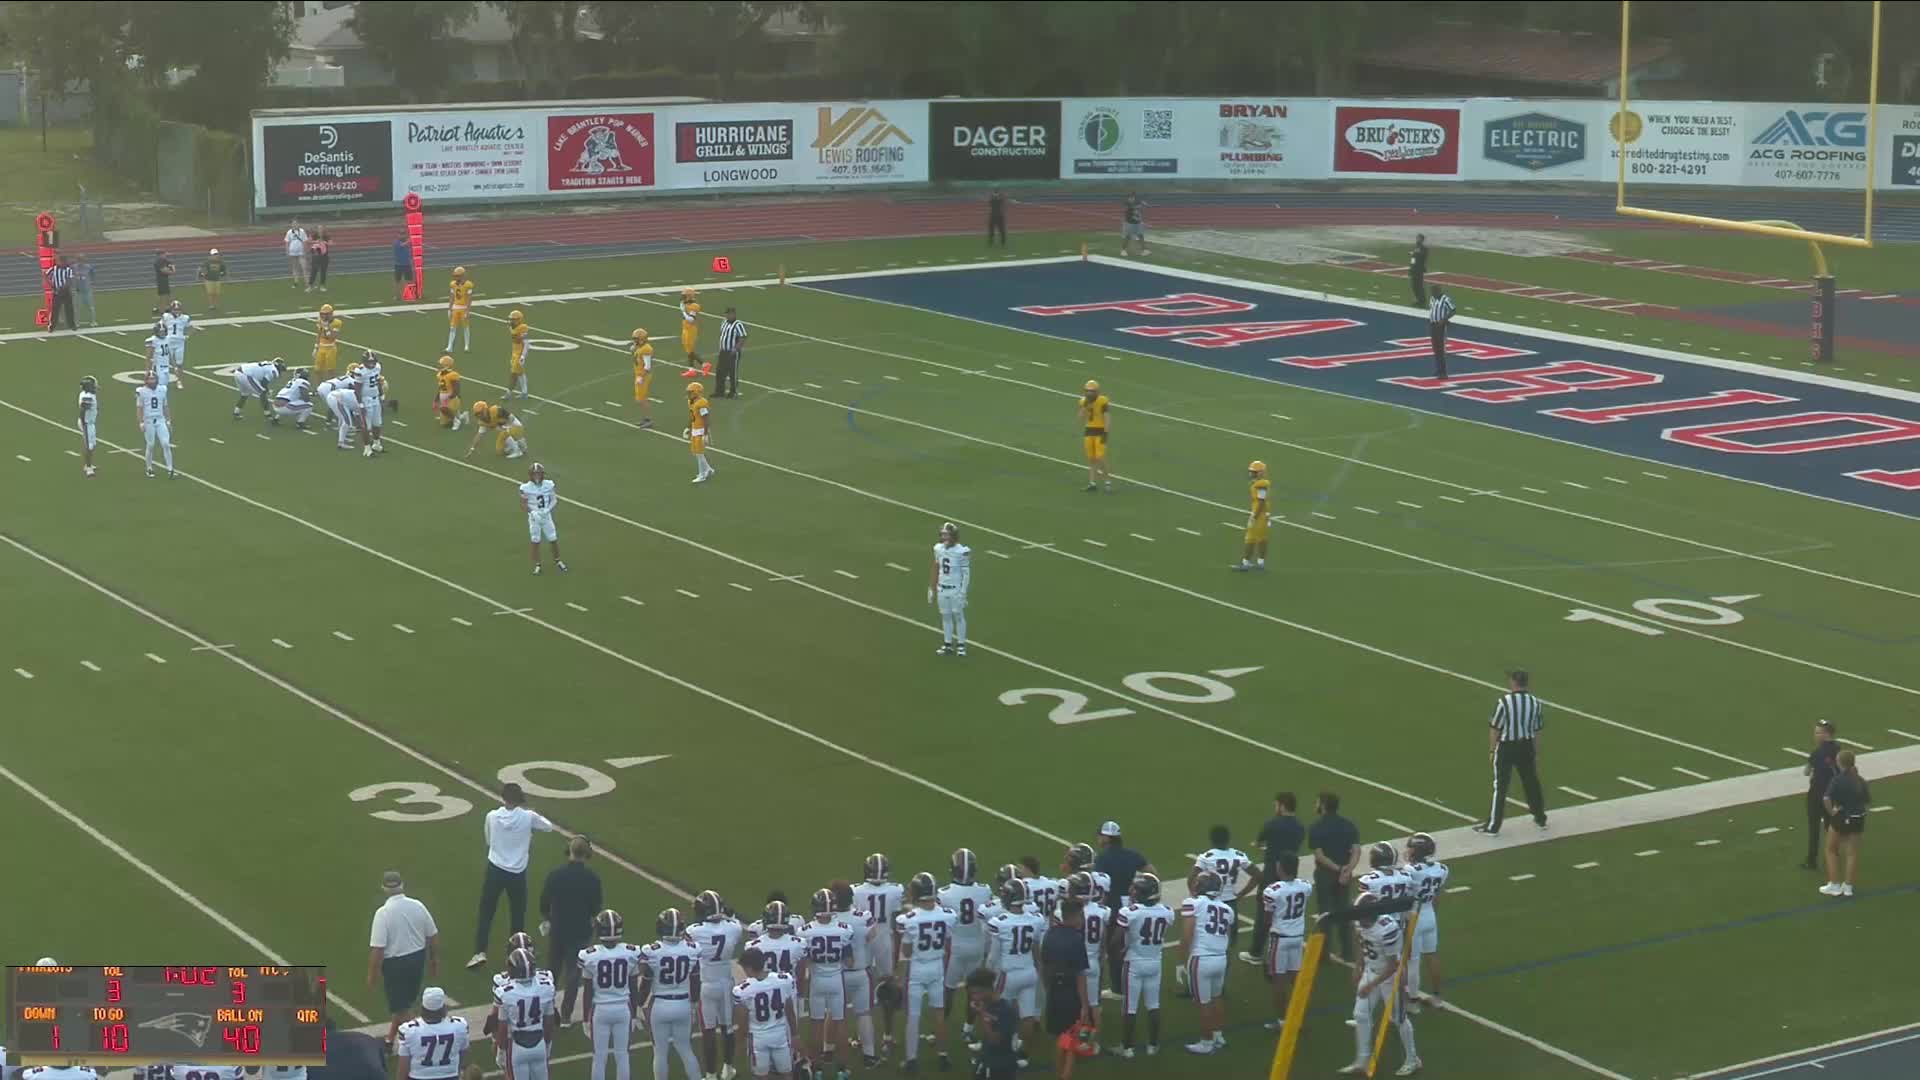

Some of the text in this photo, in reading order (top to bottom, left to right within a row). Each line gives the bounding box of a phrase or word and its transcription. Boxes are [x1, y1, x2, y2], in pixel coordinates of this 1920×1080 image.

[1219, 104, 1287, 117] BRYAN
[1674, 115, 1690, 124] YOU
[408, 120, 526, 143] Patriot Aquatics
[554, 116, 649, 152] LAKE BRANTLEY POP WARNER
[696, 125, 788, 145] HURRICANE
[953, 126, 1047, 147] DAGER
[1490, 129, 1579, 149] ELECTRIC
[1661, 126, 1696, 136] CHOOSE
[304, 150, 355, 163] DeSantis
[696, 141, 788, 158] GRILL & WINGS
[819, 147, 905, 164] LEWIS ROOFING
[971, 147, 1047, 157] CONSTRUCTION
[1221, 153, 1283, 162] PLUMBING
[1750, 150, 1867, 162] ACG ROOFING
[298, 164, 362, 178] Roofing Inc
[704, 169, 778, 182] LONGWOOD
[1632, 163, 1708, 175] 800-221-4291
[303, 181, 358, 192] 321-501-6220
[562, 175, 642, 186] TRADITION STARTS HERE
[172, 324, 178, 335] 1
[537, 495, 545, 509] 3
[942, 558, 951, 574] 6
[1562, 598, 1745, 635] 10
[998, 671, 1236, 725] 20
[347, 760, 617, 823] 30
[867, 894, 887, 924] 11
[960, 898, 974, 925] 8
[1204, 904, 1230, 936] 35
[918, 921, 946, 951] 53
[1008, 925, 1034, 956] 16
[1140, 917, 1167, 946] 40
[711, 935, 728, 962] 7
[811, 935, 841, 963] 25
[597, 958, 628, 989] 80
[659, 955, 690, 985] 20
[516, 996, 542, 1027] 14
[754, 988, 785, 1022] 84
[421, 1033, 455, 1066] 77
